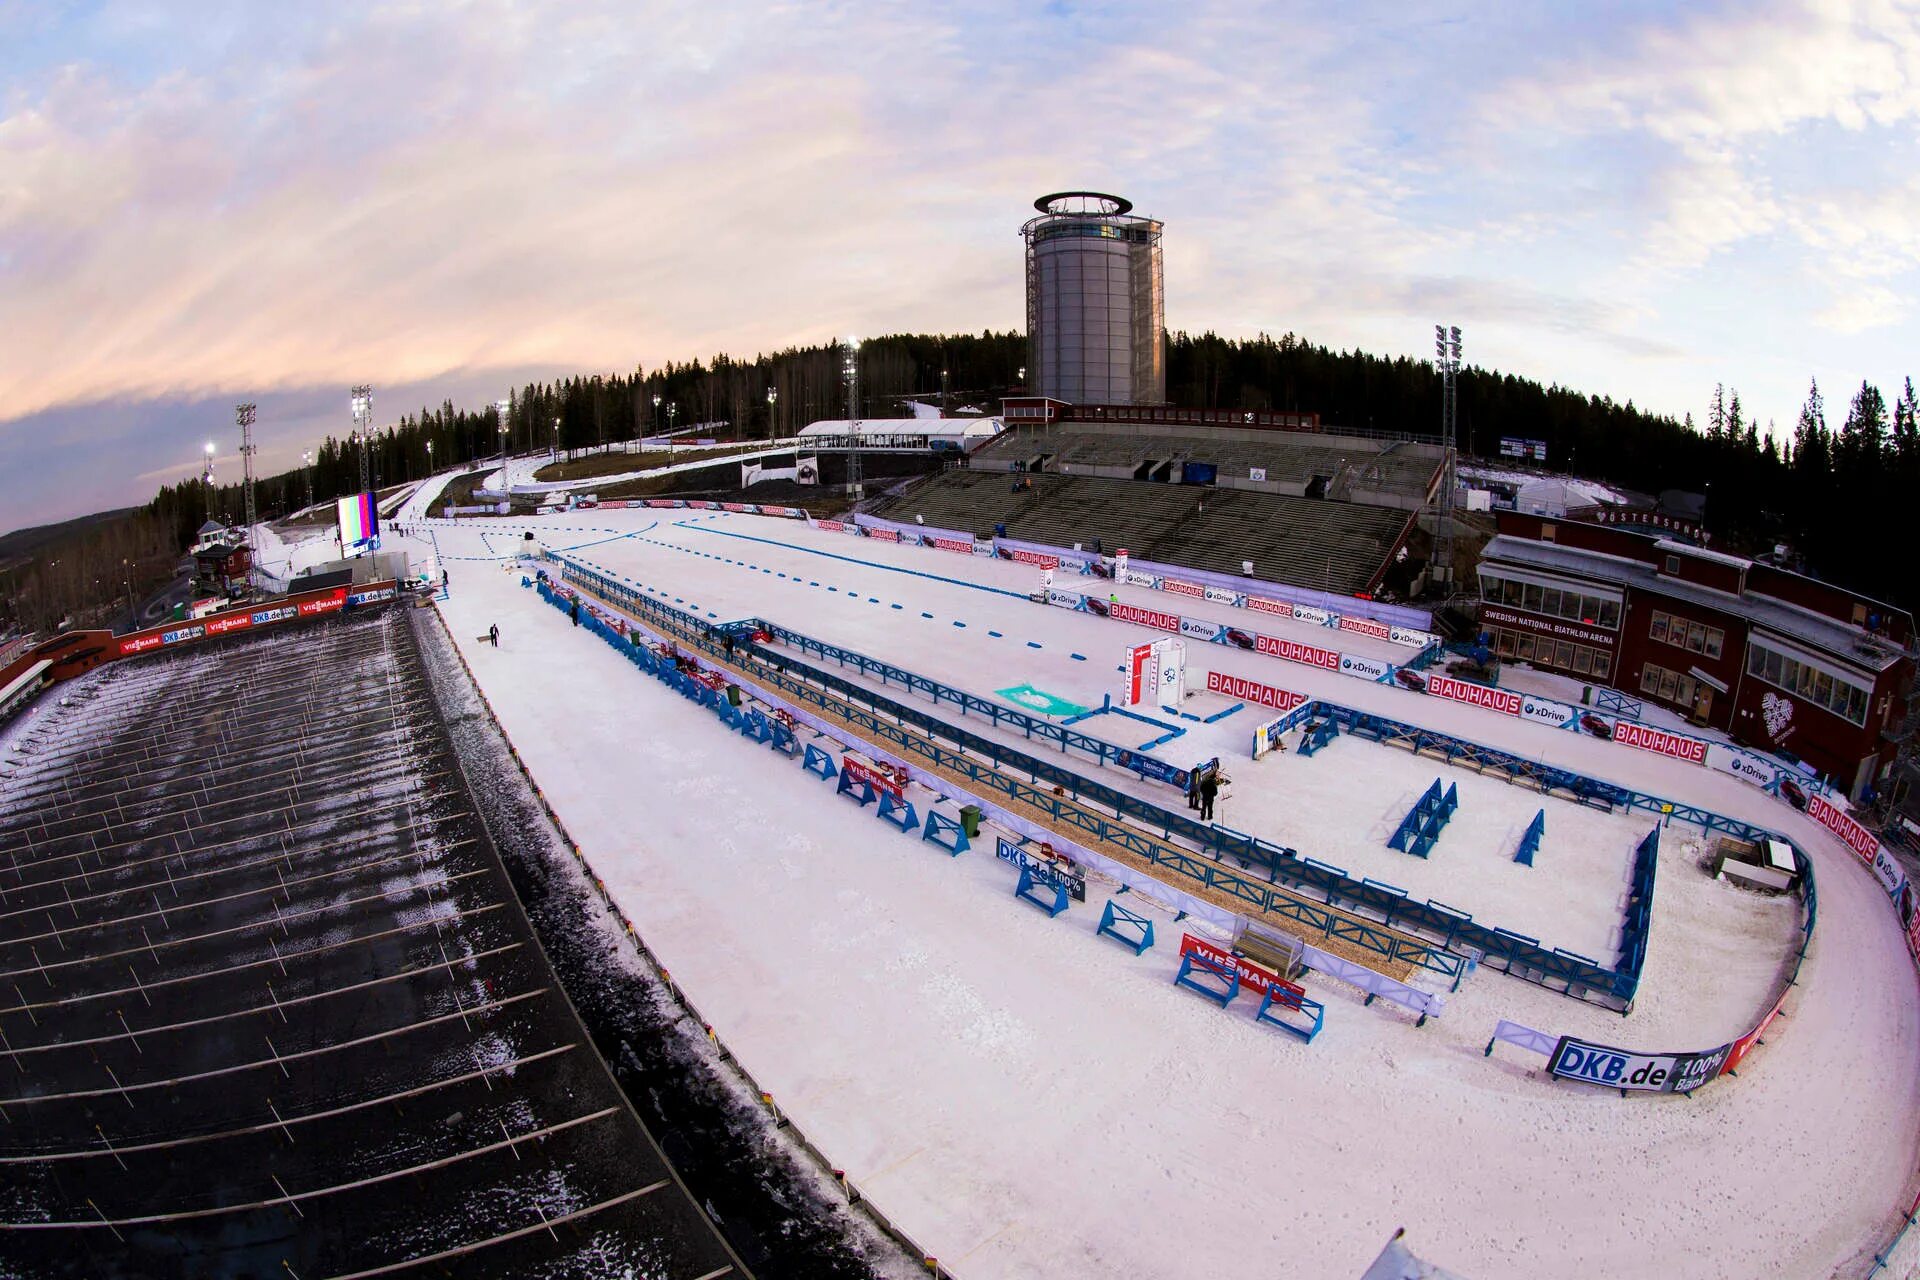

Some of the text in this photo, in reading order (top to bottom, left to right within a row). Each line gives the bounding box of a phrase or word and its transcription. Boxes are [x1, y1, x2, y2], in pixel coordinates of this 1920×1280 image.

[935, 539, 972, 553] BAUHAUS
[1133, 576, 1151, 585] xDrive
[1164, 582, 1203, 597] BAUHAUS
[1213, 593, 1233, 602] xDrive
[1058, 595, 1077, 605] xDrive
[1248, 599, 1292, 616] BAUHAUS
[253, 609, 280, 623] DKB.de
[1111, 603, 1178, 630] BAUHAUS
[1303, 613, 1324, 623] xDrive
[1190, 624, 1215, 637] xDrive
[1341, 620, 1389, 639] BAUHAUS
[1485, 610, 1613, 645] SWEDISH NATIONAL BIATHLON ARENA
[163, 630, 188, 643] DKB.de
[1400, 635, 1423, 646] xDrive
[1257, 637, 1338, 667] BAUHAUS
[1352, 662, 1381, 676] xDrive
[1209, 673, 1303, 708] BAUHAUS
[1430, 678, 1520, 712] BAUHAUS
[1535, 707, 1565, 722] xDrive
[1615, 725, 1703, 760] BAUHAUS
[1741, 763, 1768, 783] xDrive
[1809, 798, 1876, 862] BAUHAUS
[1054, 871, 1081, 892] 100%
[1881, 860, 1898, 887] xDrive
[1557, 1045, 1667, 1086] DKB.de
[1683, 1051, 1723, 1077] 100%
[1675, 1074, 1708, 1091] Bank
